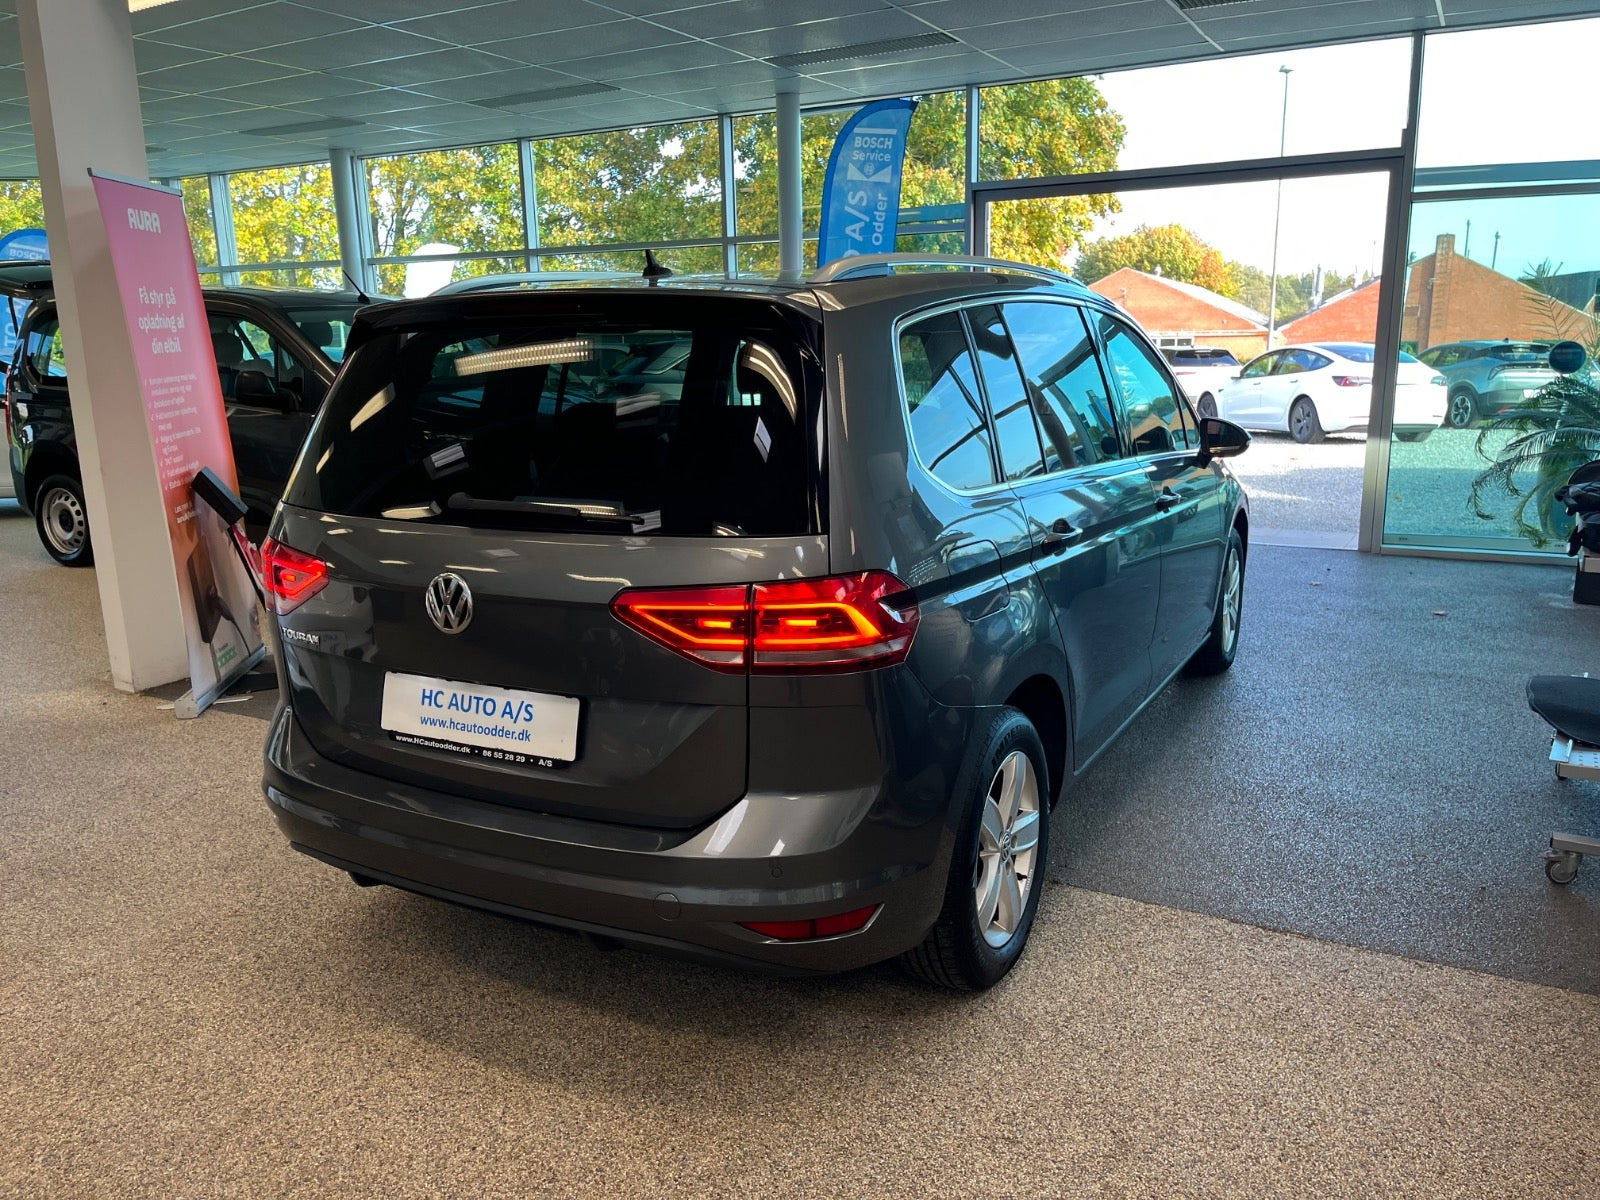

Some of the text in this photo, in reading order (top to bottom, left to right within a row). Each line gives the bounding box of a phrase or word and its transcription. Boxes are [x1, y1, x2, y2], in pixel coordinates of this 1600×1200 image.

[855, 136, 893, 149] BOSCH
[852, 150, 892, 161] Service
[127, 207, 162, 234] AURA
[845, 190, 870, 242] A/S
[871, 193, 888, 246] Odder
[10, 249, 43, 260] BOSCH
[138, 285, 176, 308] Få styr på
[138, 313, 177, 334] opladning
[151, 336, 182, 354] din elbil
[281, 627, 320, 645] TOURAN
[421, 688, 534, 724] HC AUTO A/S
[420, 716, 532, 742] www.hcautoodder.dk
[395, 735, 553, 767] www.HCautoodder.dk 86 55 28 29 A/S
